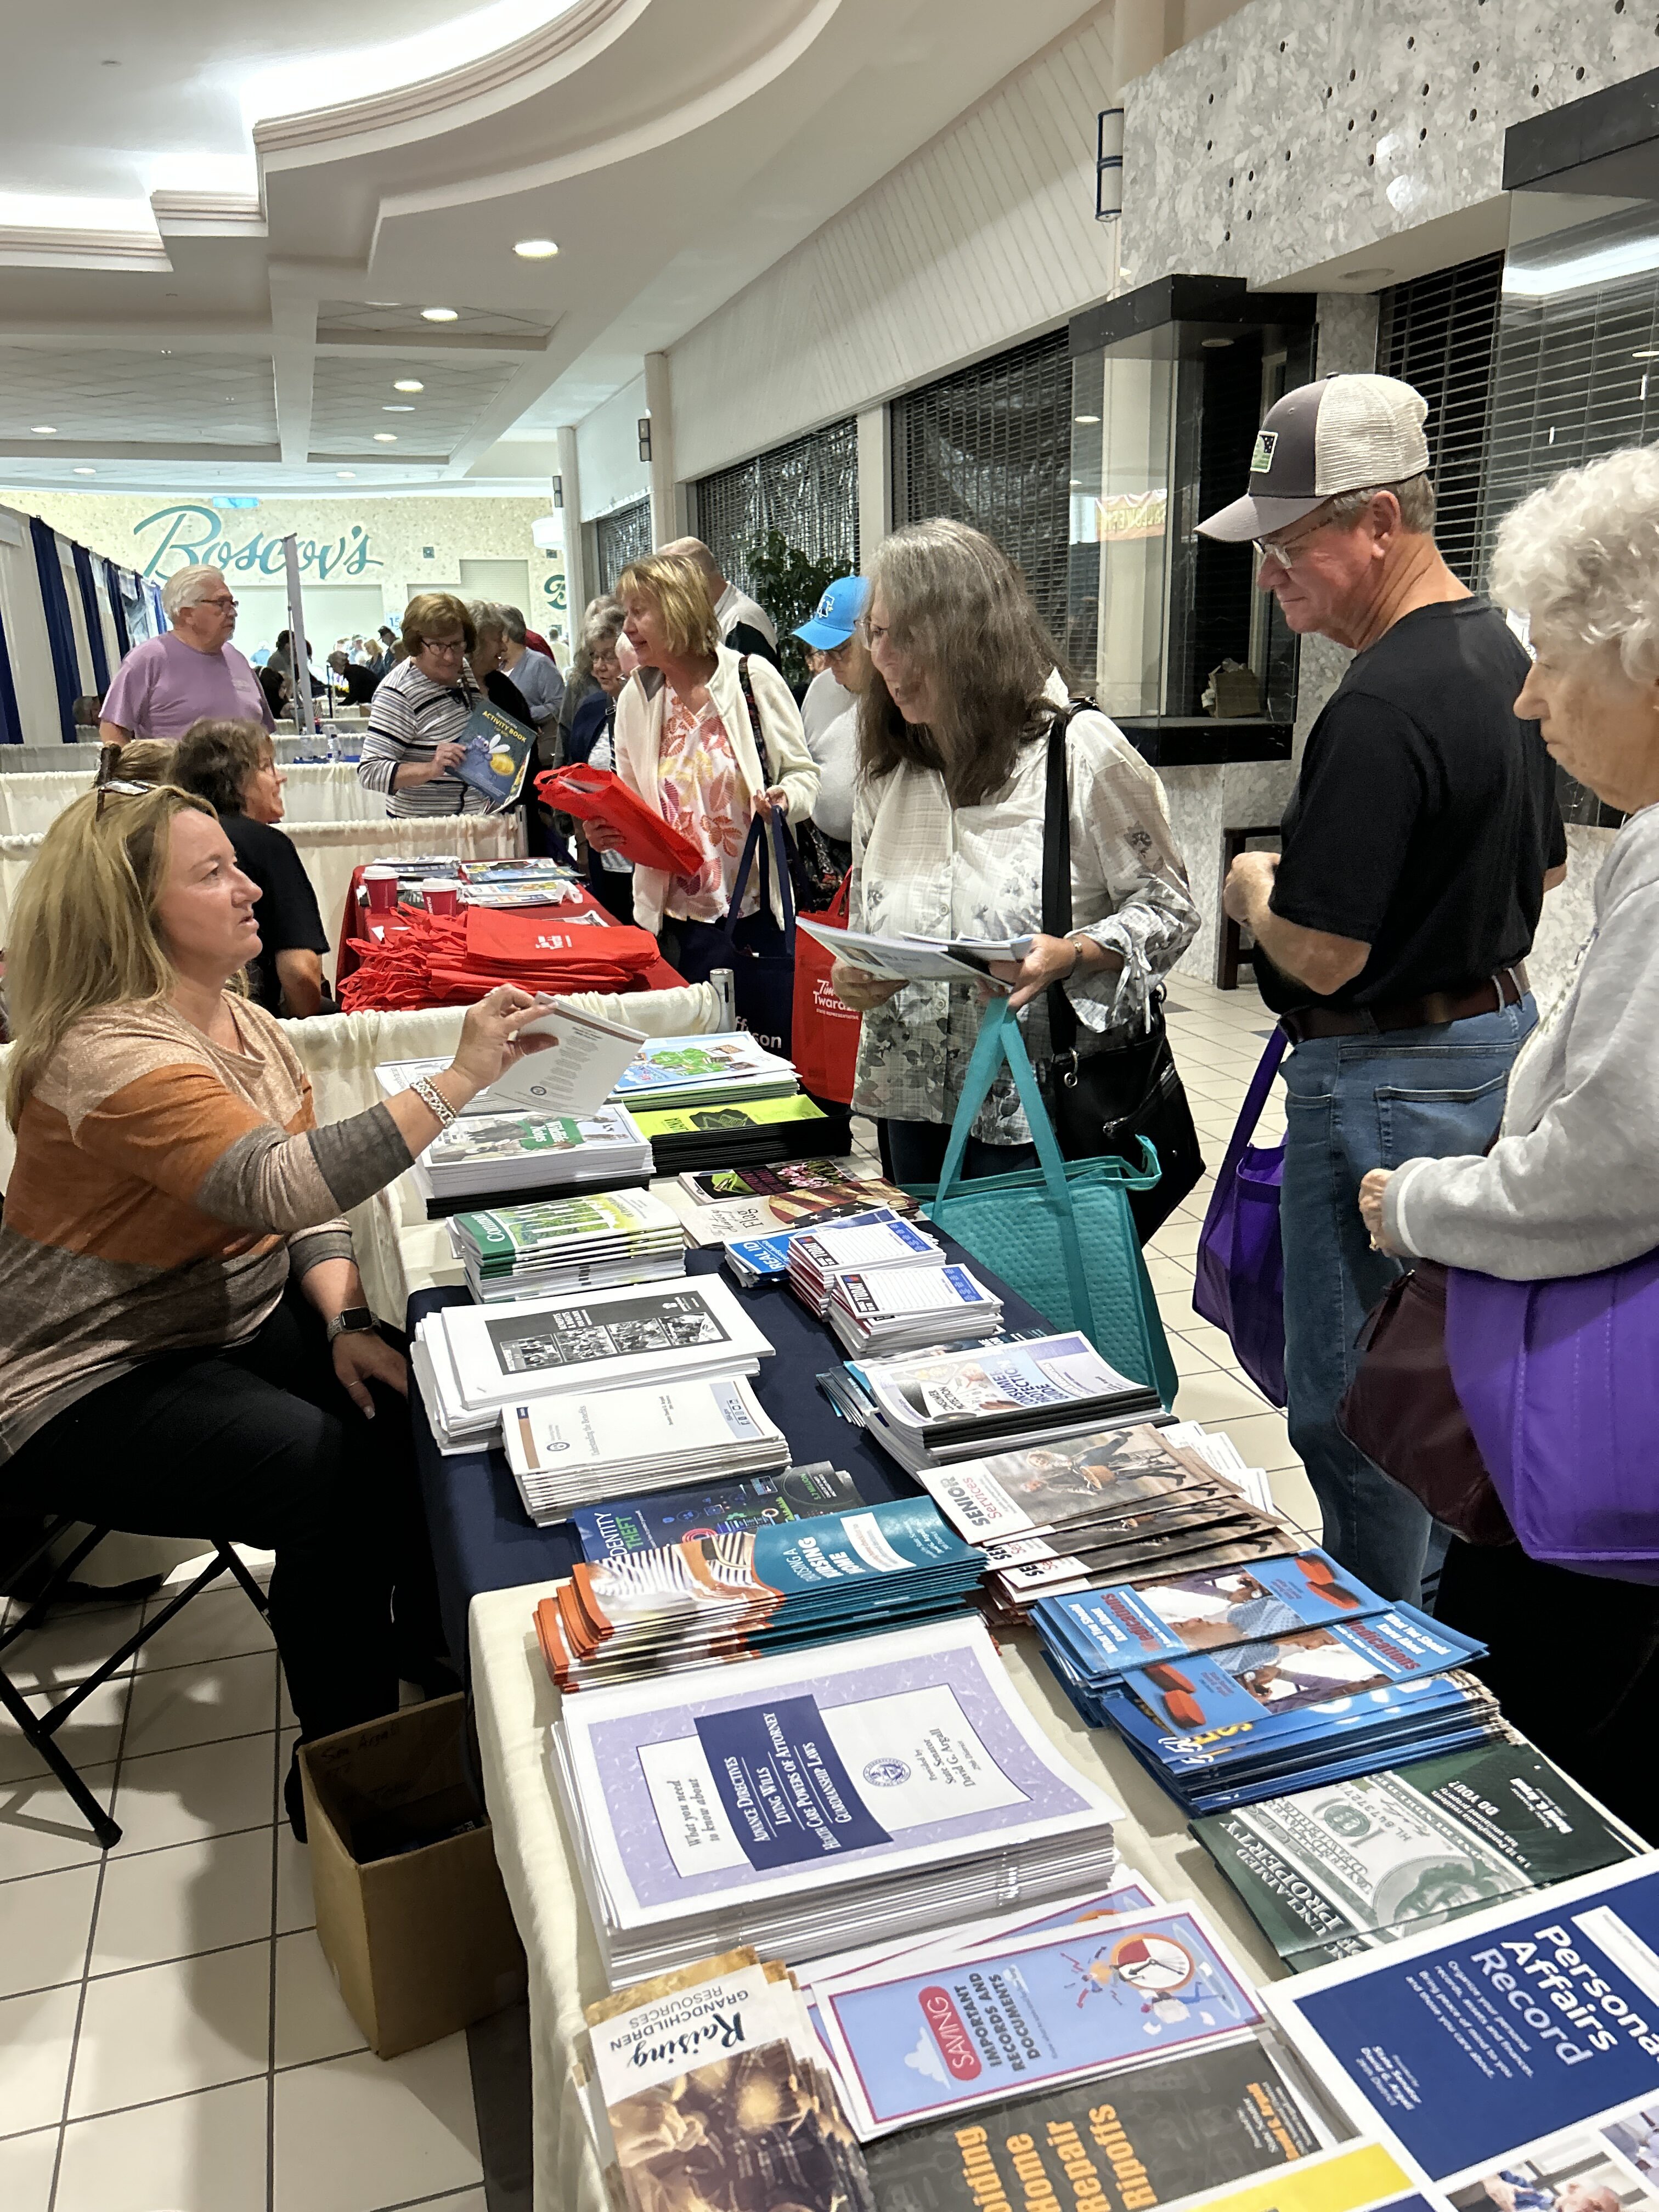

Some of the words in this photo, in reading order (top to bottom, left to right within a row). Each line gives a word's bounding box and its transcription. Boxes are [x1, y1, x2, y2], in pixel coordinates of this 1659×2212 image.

[133, 505, 384, 580] Boscov's
[482, 710, 510, 730] ACTIVITY
[509, 727, 527, 743] BOOK
[529, 1125, 546, 1142] Notes
[546, 1121, 568, 1143] Wildlife
[485, 1212, 506, 1244] Common
[737, 1209, 764, 1227] Flag
[744, 1242, 761, 1251] ID
[754, 1251, 783, 1268] REAL
[803, 1242, 827, 1257] TODAY
[848, 1283, 869, 1299] TODAY
[989, 1370, 1039, 1406] CONSUMER
[996, 1359, 1048, 1403] PROTECTION
[1035, 1384, 1069, 1400] GUIDE
[579, 1405, 591, 1424] Benefits
[585, 1431, 600, 1455] Understanding
[800, 1473, 816, 1493] MILLION
[962, 1476, 1002, 1519] Services
[940, 1475, 991, 1526] SENIOR
[594, 1513, 628, 1556] DENTITY
[616, 1516, 643, 1549] THEFT
[798, 1537, 844, 1576] NURSING
[830, 1551, 866, 1573] HOME
[1068, 1601, 1093, 1625] Should
[1090, 1606, 1111, 1626] About
[1088, 1623, 1103, 1637] You
[1098, 1634, 1118, 1654] What
[1107, 1623, 1128, 1642] Know
[1375, 1622, 1402, 1640] Know
[1398, 1637, 1426, 1655] About
[1383, 1612, 1408, 1630] What
[1403, 1626, 1422, 1640] You
[1417, 1636, 1452, 1656] Should
[763, 1711, 792, 1757] ATTORNEY
[929, 1727, 952, 1752] Argall
[783, 1758, 796, 1771] OF
[803, 1741, 822, 1767] LAWS
[918, 1757, 938, 1780] Provided
[923, 1739, 944, 1766] Senator
[947, 1753, 958, 1763] G.
[666, 1780, 687, 1801] need
[689, 1778, 705, 1804] about
[724, 1756, 753, 1807] DIRECTIVES
[757, 1765, 778, 1793] WILLS
[787, 1769, 814, 1805] POWERS
[940, 1768, 957, 1784] State
[953, 1765, 976, 1787] David
[1447, 1779, 1481, 1804] YOU?
[768, 1793, 792, 1825] LIVING
[815, 1767, 853, 1822] GUARDIANSHIP
[1430, 1790, 1464, 1814] residents
[1476, 1798, 1500, 1816] DO
[681, 1804, 697, 1822] you
[699, 1808, 715, 1832] know
[744, 1807, 771, 1842] ADVANCE
[804, 1805, 823, 1827] CARE
[1466, 1807, 1505, 1835] unclaimed
[685, 1824, 702, 1847] What
[1460, 1811, 1509, 1850] Pennsylvania
[1502, 1833, 1520, 1847] has
[1217, 1819, 1345, 1929] PROPERTY
[1310, 1839, 1373, 1893] UNITED
[1234, 1847, 1328, 1937] UNCLAIMED
[970, 1973, 993, 2002] AND
[1500, 1939, 1618, 2055] Affairs
[1533, 1924, 1659, 2063] Persona
[611, 1989, 749, 2052] GRANDCHILDREN
[629, 1985, 724, 2029] RESOURCES
[990, 1973, 1041, 2059] DOCUMENTS
[1404, 1975, 1425, 1993] and
[1418, 1990, 1442, 2016] those
[1437, 2015, 1457, 2034] you
[1452, 2031, 1472, 2052] care
[1446, 1959, 1482, 1997] Organize
[1477, 1996, 1500, 2016] your
[1494, 2016, 1532, 2053] personal
[1460, 1997, 1488, 2024] assets
[1485, 2024, 1505, 2042] and
[1470, 1946, 1594, 2066] Record
[627, 2011, 748, 2069] Raising
[927, 1996, 975, 2070] SAVING
[955, 1984, 1001, 2067] IMPORTANT
[986, 2007, 1026, 2072] RECORDS
[1418, 1970, 1441, 1994] Bring
[1435, 1993, 1460, 2018] peace
[1458, 2016, 1472, 2029] of
[1467, 2027, 1491, 2050] mind
[1486, 2049, 1499, 2061] to
[1493, 2060, 1514, 2079] you
[1006, 2132, 1062, 2212] Home
[1046, 2119, 1113, 2212] Repair
[1088, 2103, 1158, 2211] Ripoffs
